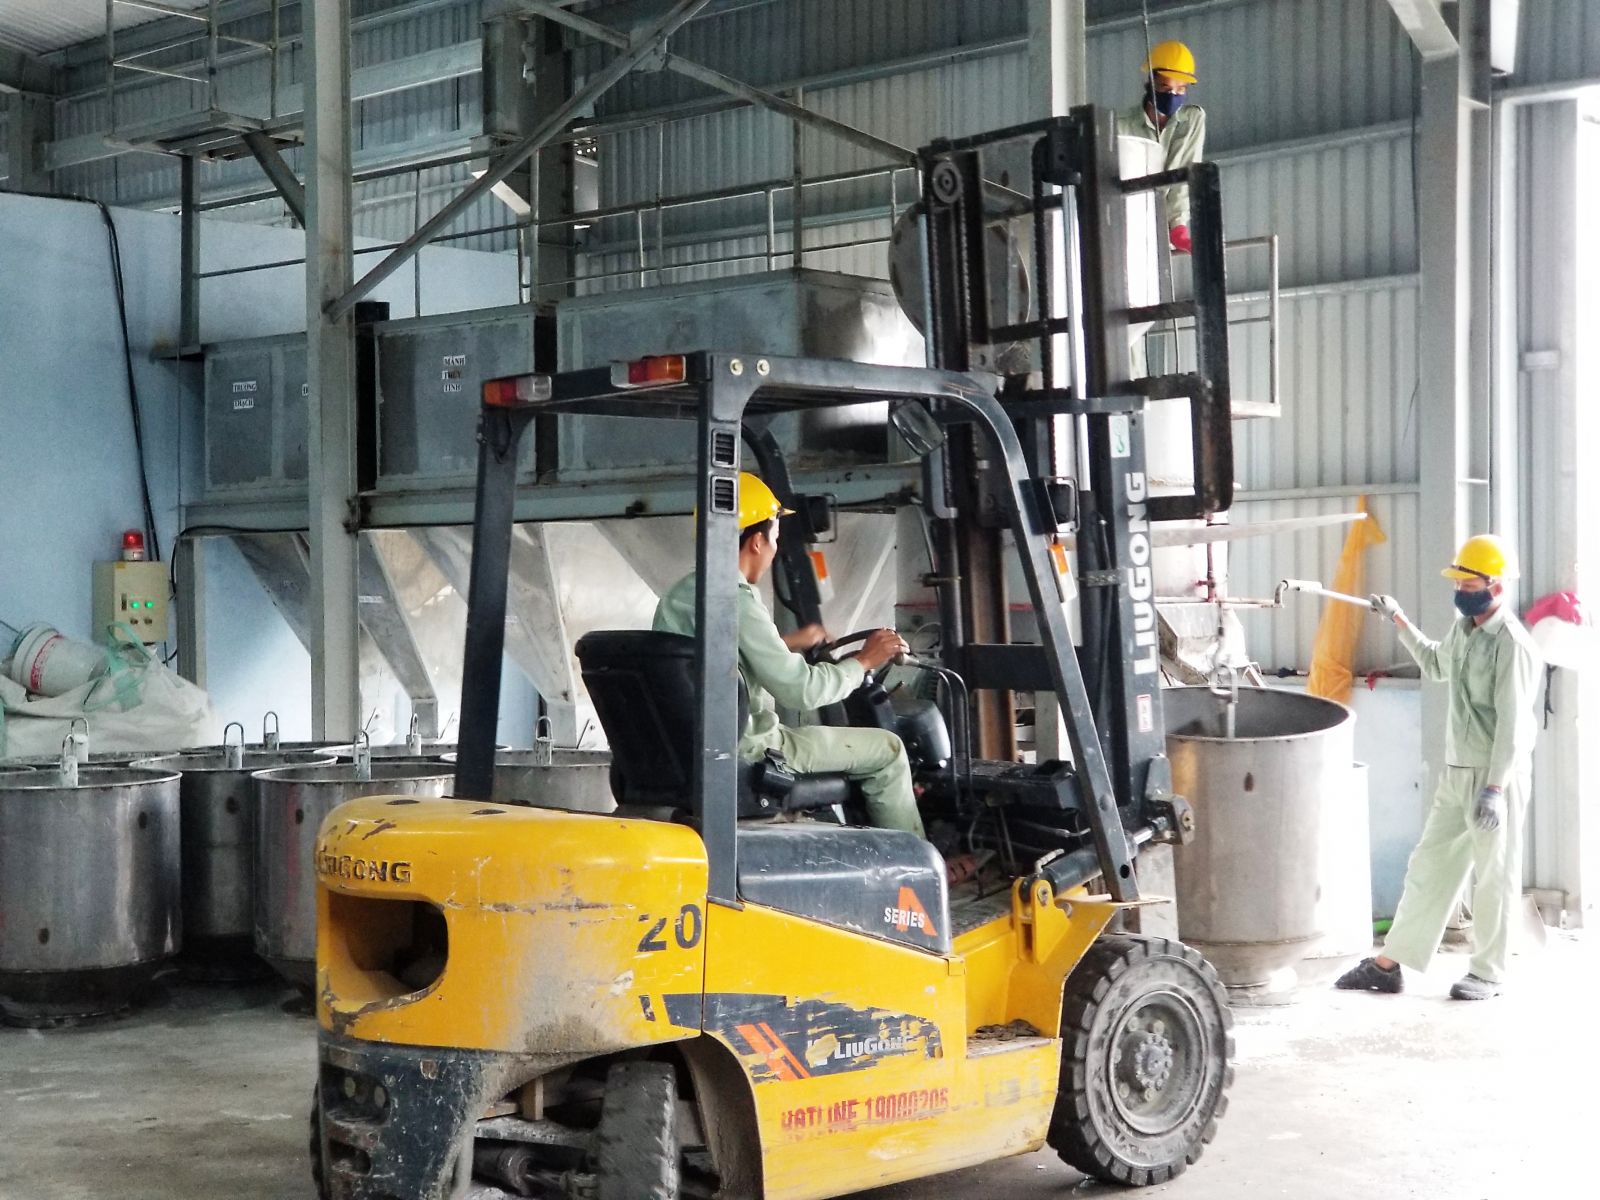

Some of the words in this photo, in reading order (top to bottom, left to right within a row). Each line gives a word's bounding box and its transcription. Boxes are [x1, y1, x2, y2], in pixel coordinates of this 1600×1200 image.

[1125, 472, 1157, 675] LIUGONG
[636, 903, 702, 952] 20
[884, 907, 925, 928] SERIES
[896, 886, 938, 937] A
